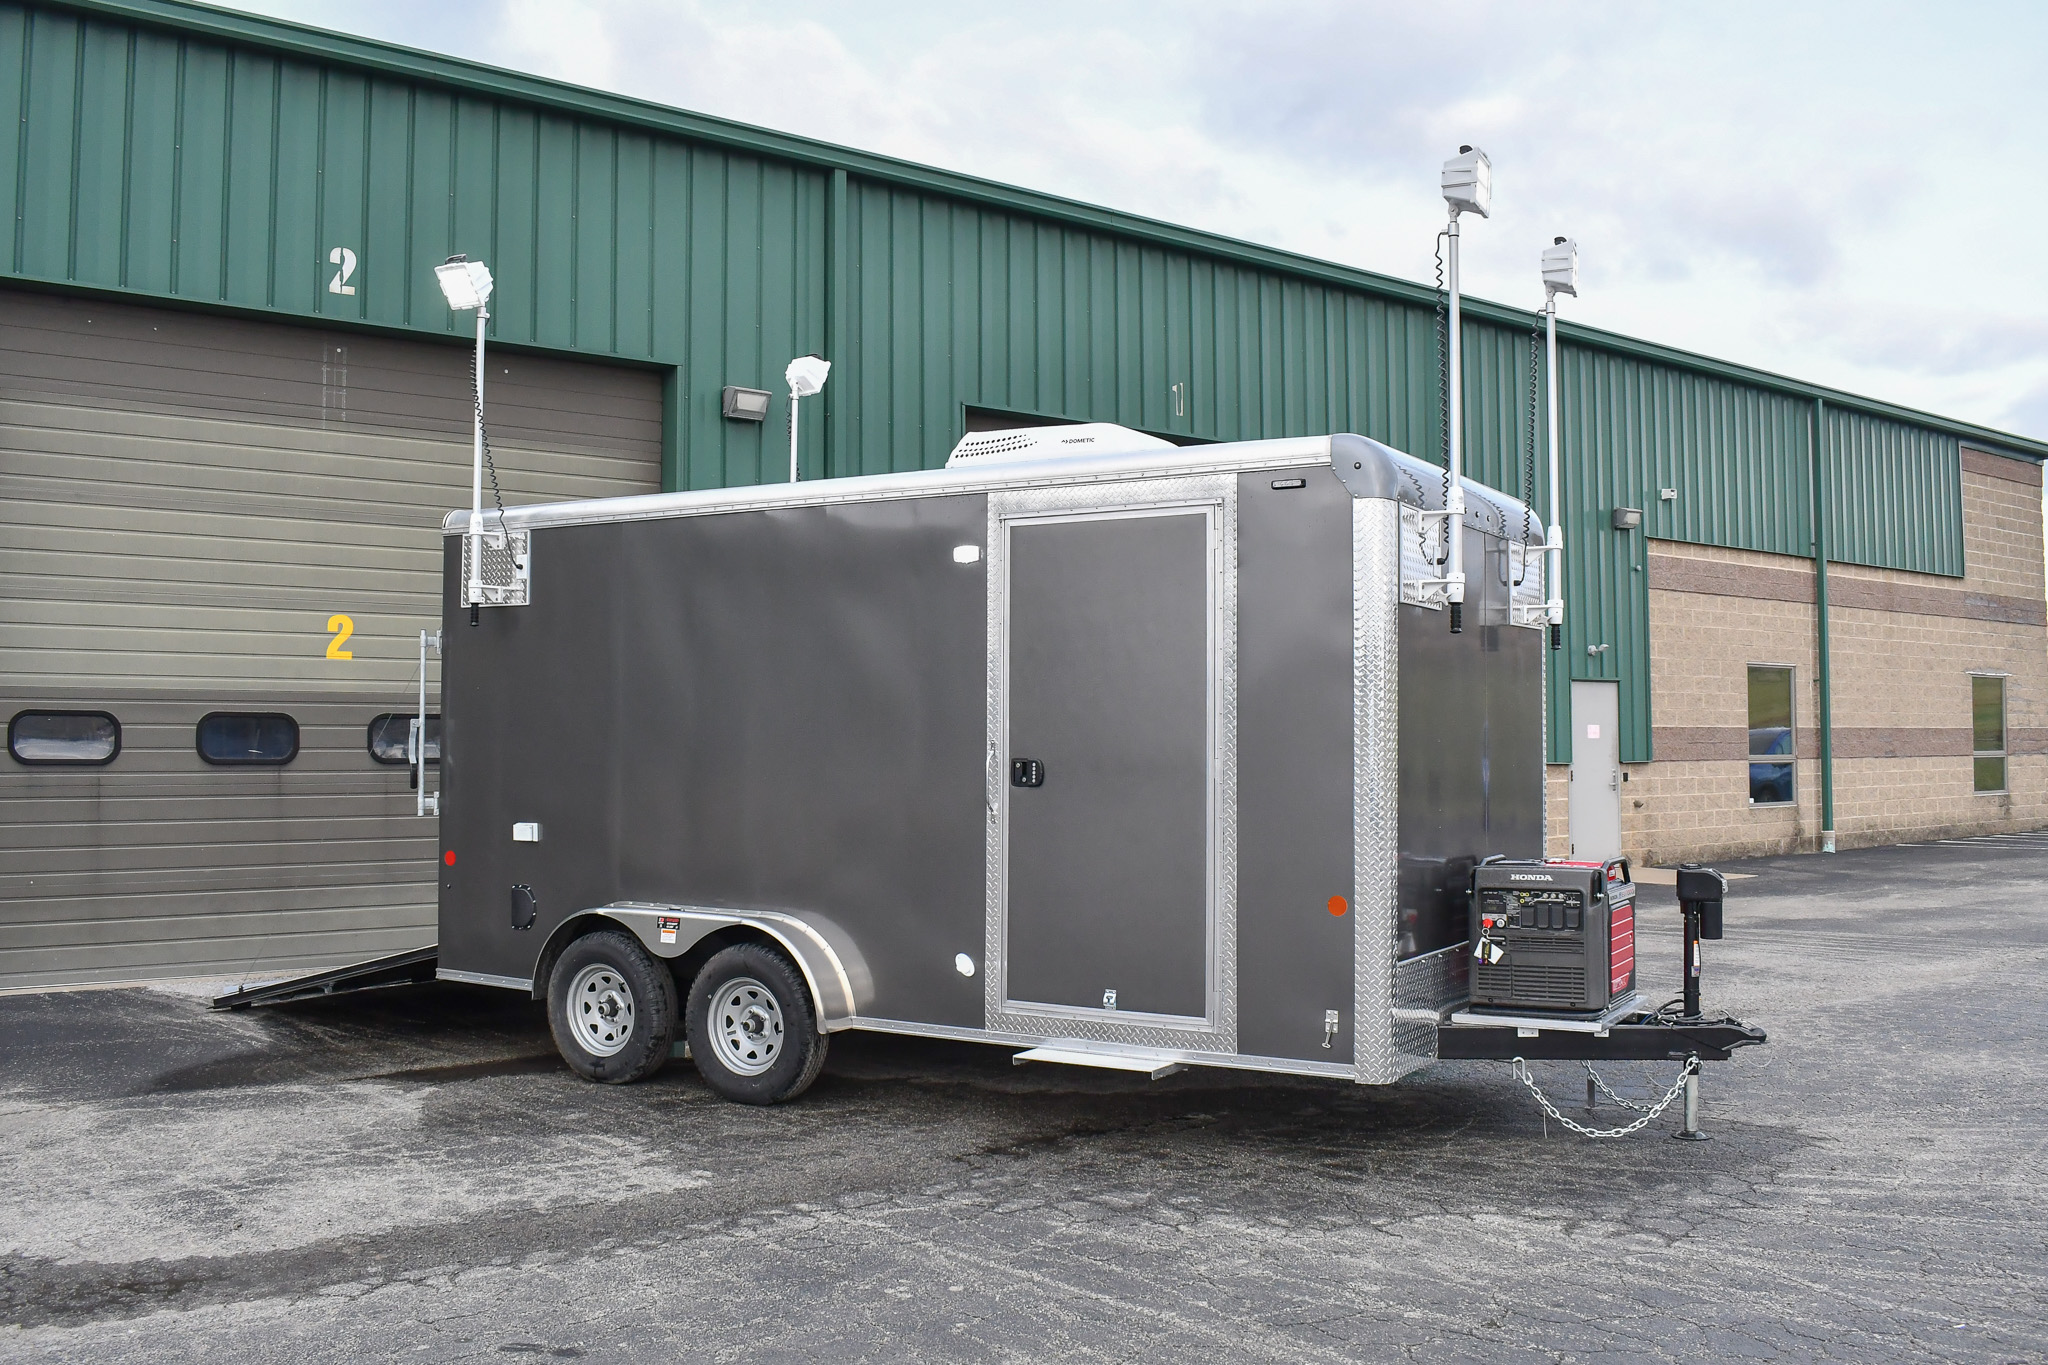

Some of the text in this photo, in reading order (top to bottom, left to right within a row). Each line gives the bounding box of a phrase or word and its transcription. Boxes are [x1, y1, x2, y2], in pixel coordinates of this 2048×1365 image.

[329, 247, 357, 296] 2
[326, 614, 354, 660] 2
[1510, 873, 1554, 882] HONDA
